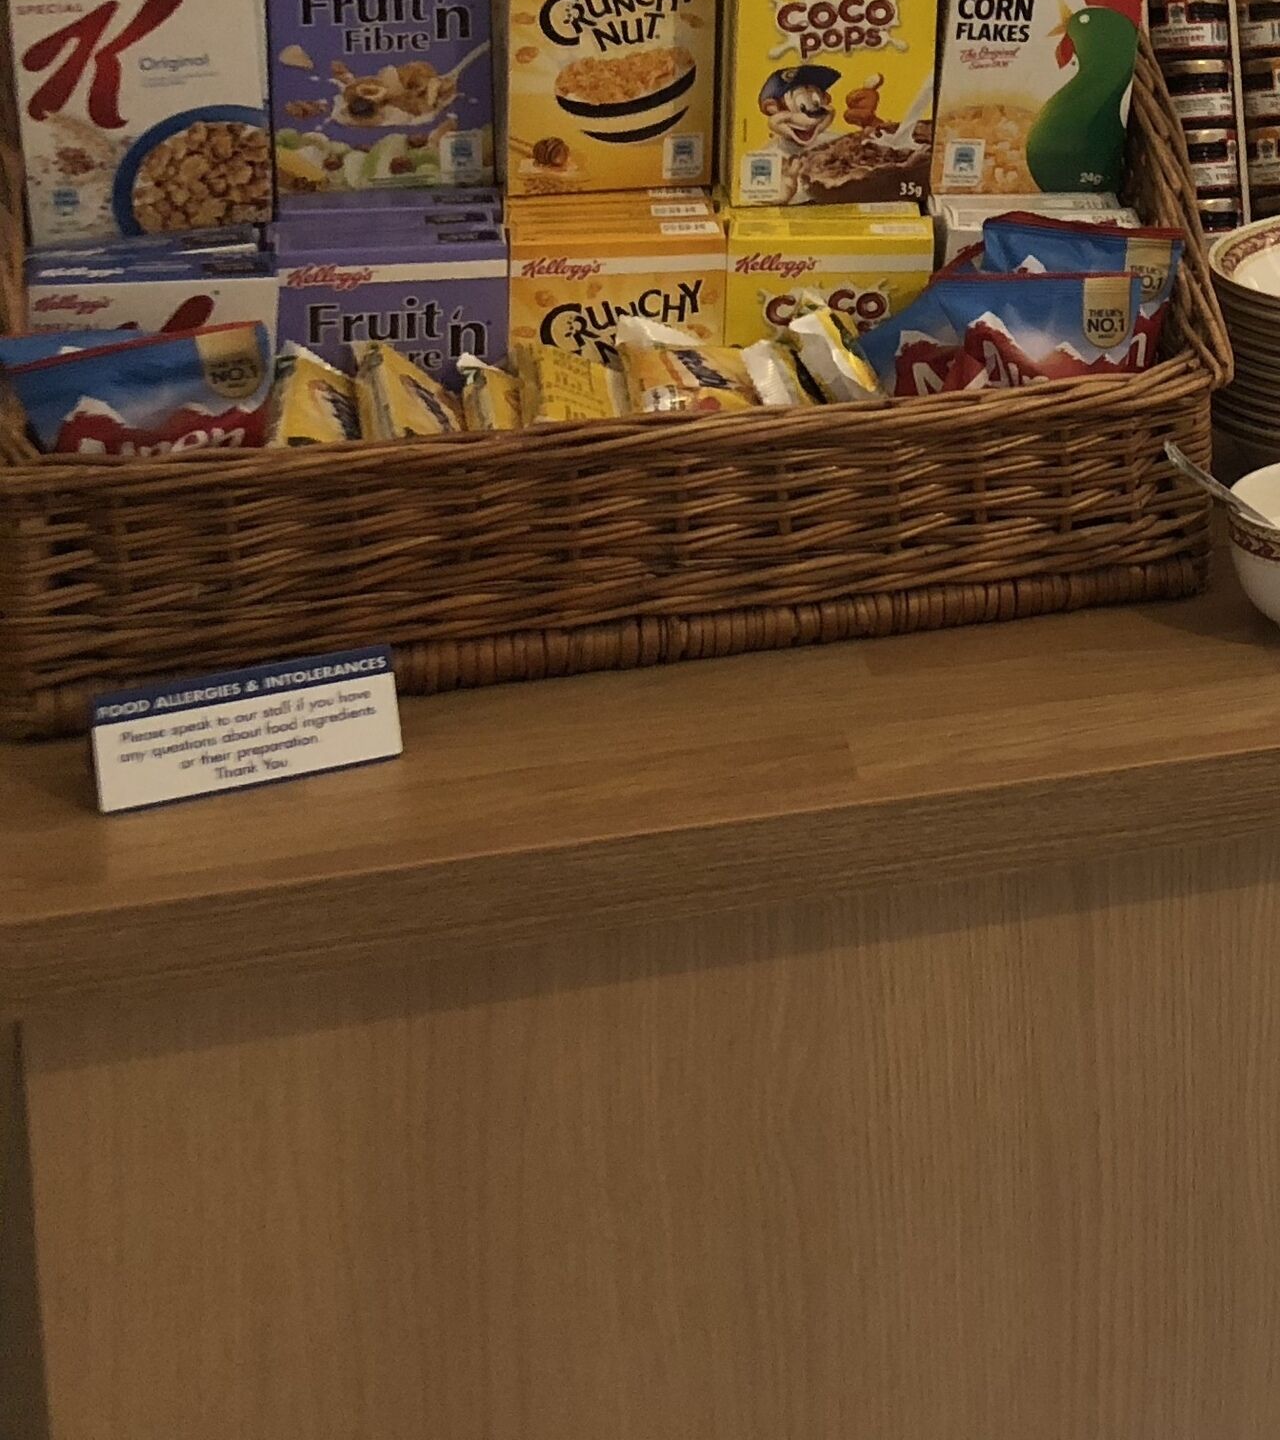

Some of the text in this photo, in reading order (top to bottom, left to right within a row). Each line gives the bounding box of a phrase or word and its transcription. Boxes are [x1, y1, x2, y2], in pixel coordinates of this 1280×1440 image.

[344, 26, 430, 55] Fibre
[591, 12, 666, 53] NUT
[955, 21, 1031, 44] FLAKES
[138, 52, 211, 73] Original
[899, 180, 923, 199] 35g
[286, 264, 375, 291] Kellogg's
[521, 256, 604, 281] Kellogg's
[735, 252, 818, 278] Kellogg's
[1142, 276, 1164, 290] O.1
[308, 294, 442, 344] Fruit
[1086, 317, 1127, 333] NO.1
[97, 656, 387, 720] FOOD ALLERGIES & INTOLERANCES
[217, 716, 231, 727] to
[309, 698, 335, 713] you
[267, 718, 299, 735] food
[215, 761, 259, 779] Thank
